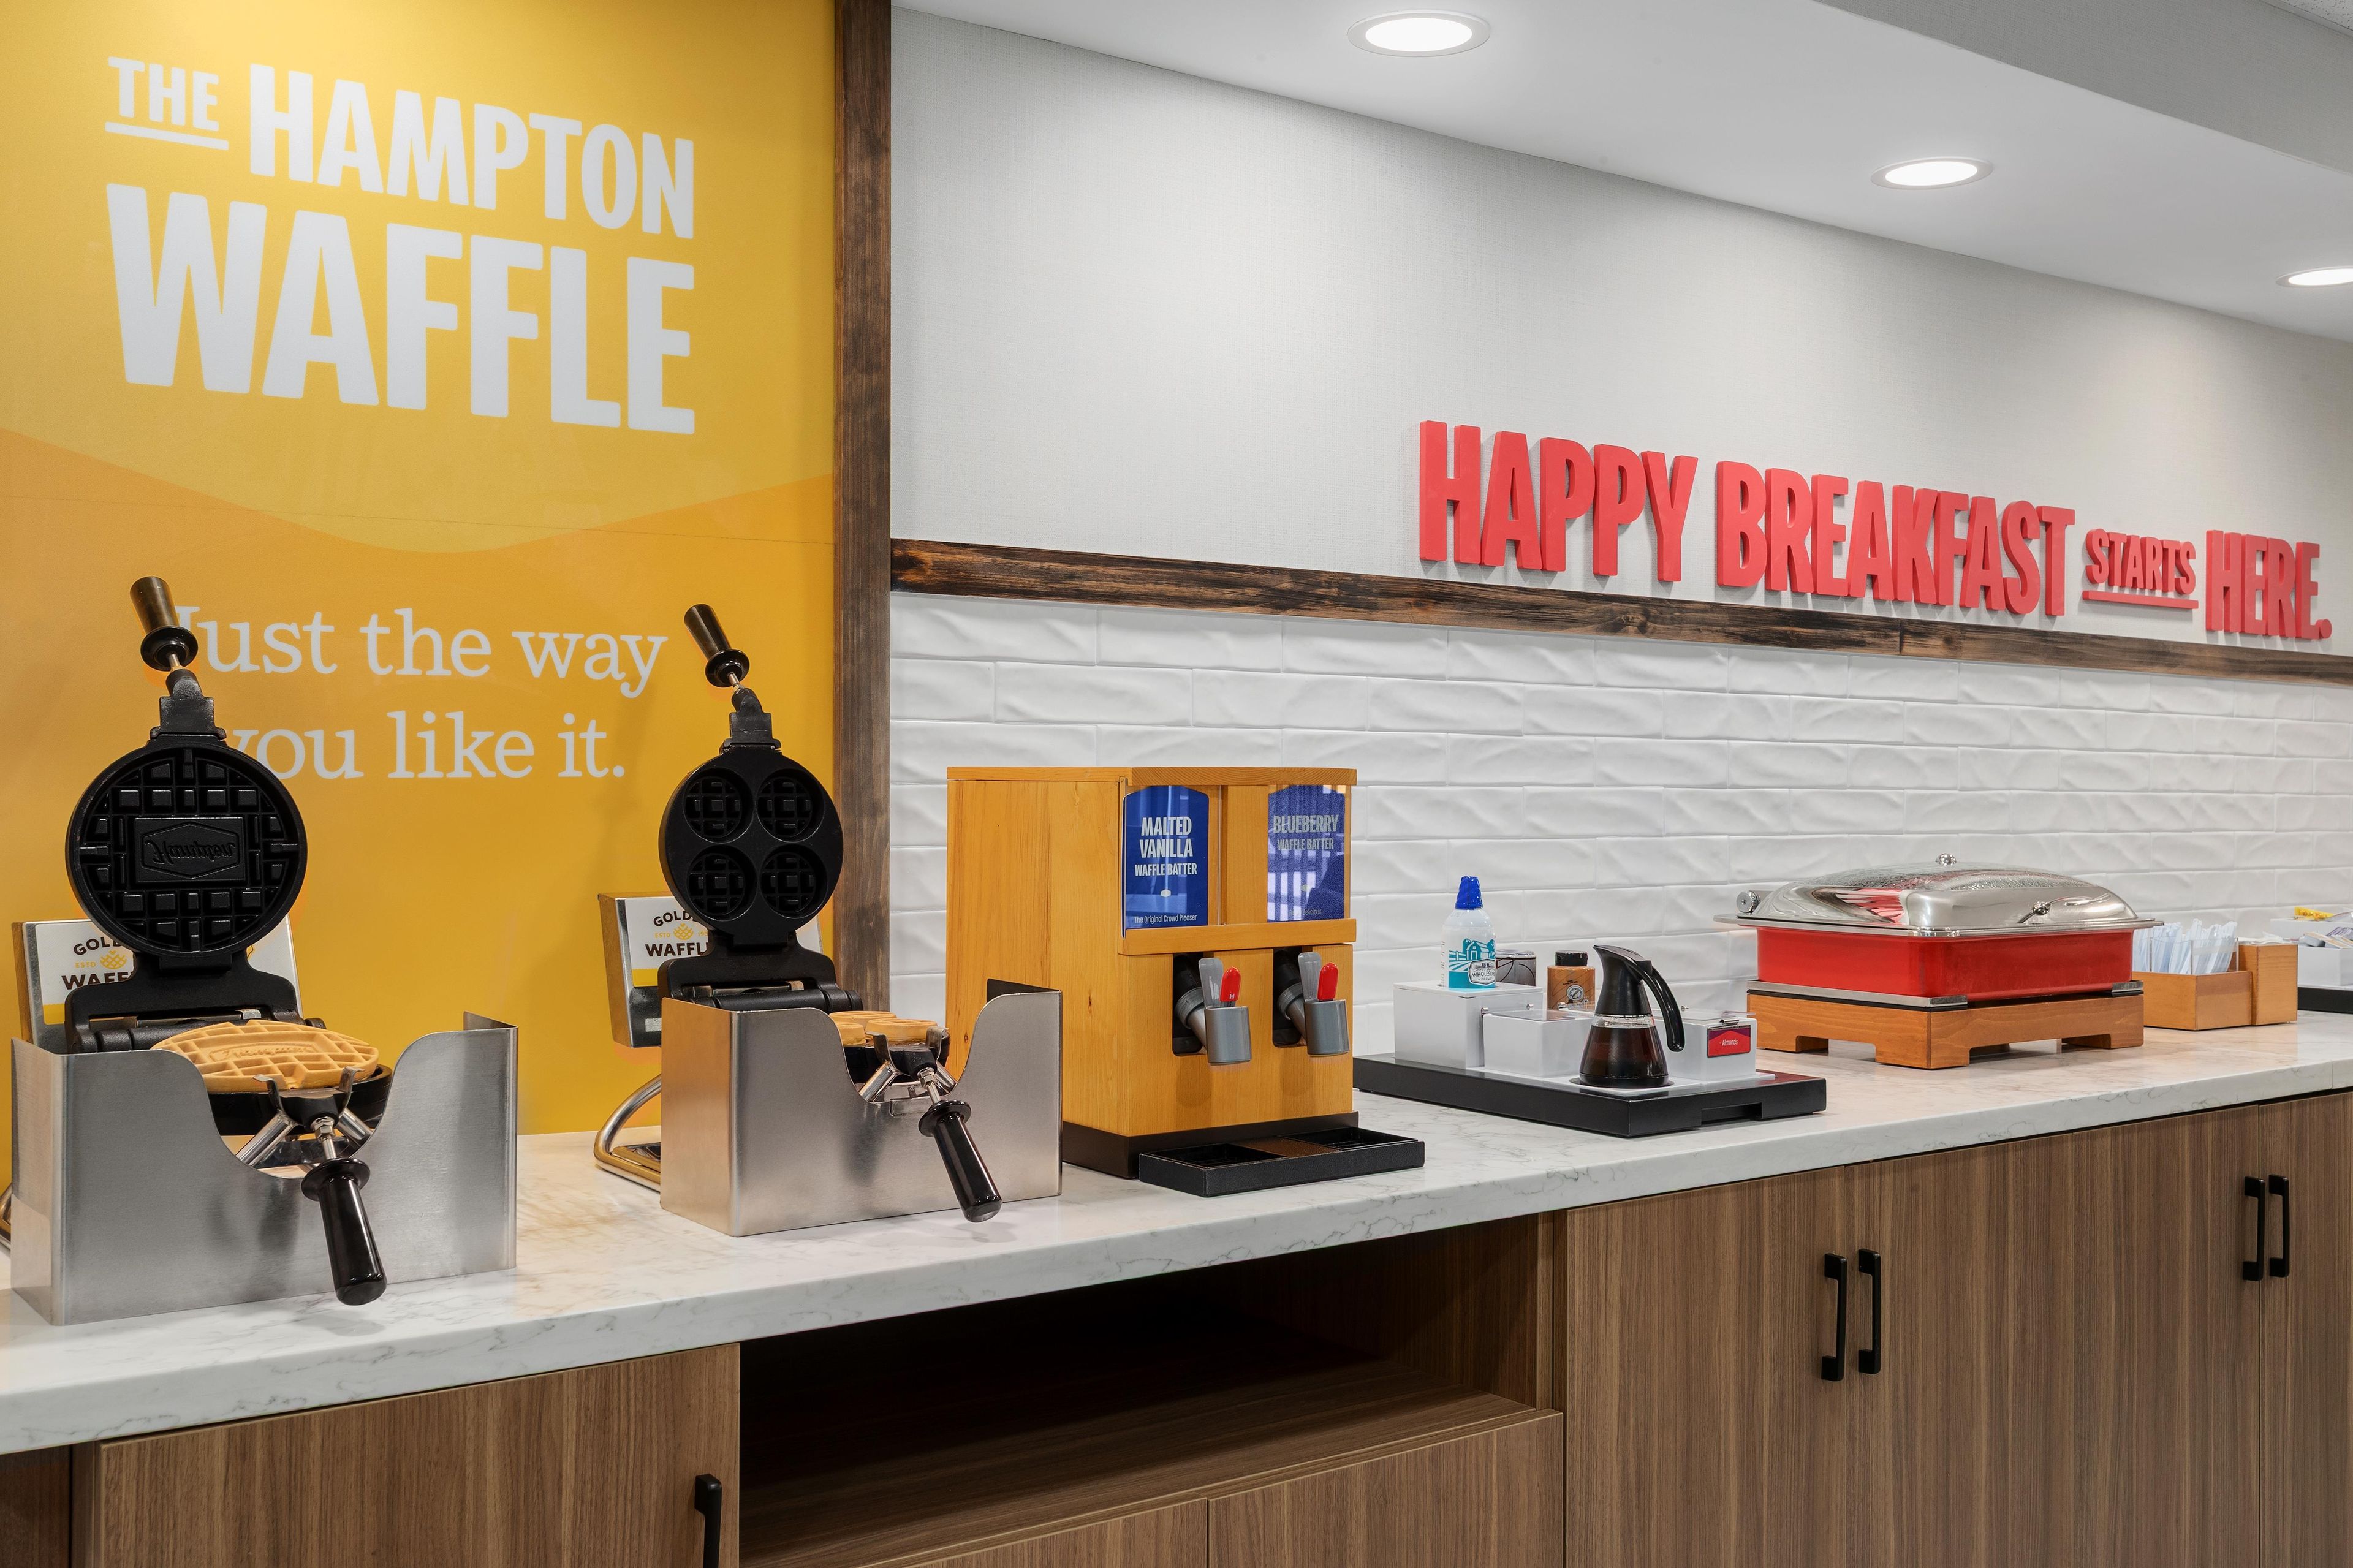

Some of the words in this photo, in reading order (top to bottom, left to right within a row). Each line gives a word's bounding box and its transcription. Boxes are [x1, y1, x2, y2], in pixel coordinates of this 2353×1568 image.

[107, 56, 220, 132] THE
[249, 62, 695, 240] HAMPTON
[105, 183, 695, 435] WAFFLE
[1419, 420, 1699, 583] HAPPY
[1715, 460, 2075, 617] BREAKFAST
[2085, 528, 2196, 596] STARTS
[2205, 529, 2332, 640] HERE.
[359, 607, 491, 677] the
[510, 631, 668, 699] way
[232, 729, 364, 781] ou
[387, 710, 534, 778] like
[557, 713, 625, 778] it.
[1141, 816, 1192, 836] MALTED
[1273, 814, 1339, 834] BLUEBERRY
[1140, 838, 1193, 858] VANILLA
[1278, 839, 1305, 850] WAFFLE
[1306, 838, 1334, 850] BATTER
[1134, 864, 1165, 876] WAFFLE
[1167, 863, 1197, 876] BATTER
[653, 911, 695, 927] GOLD
[1144, 915, 1163, 925] Original
[645, 942, 708, 956] WAFFL
